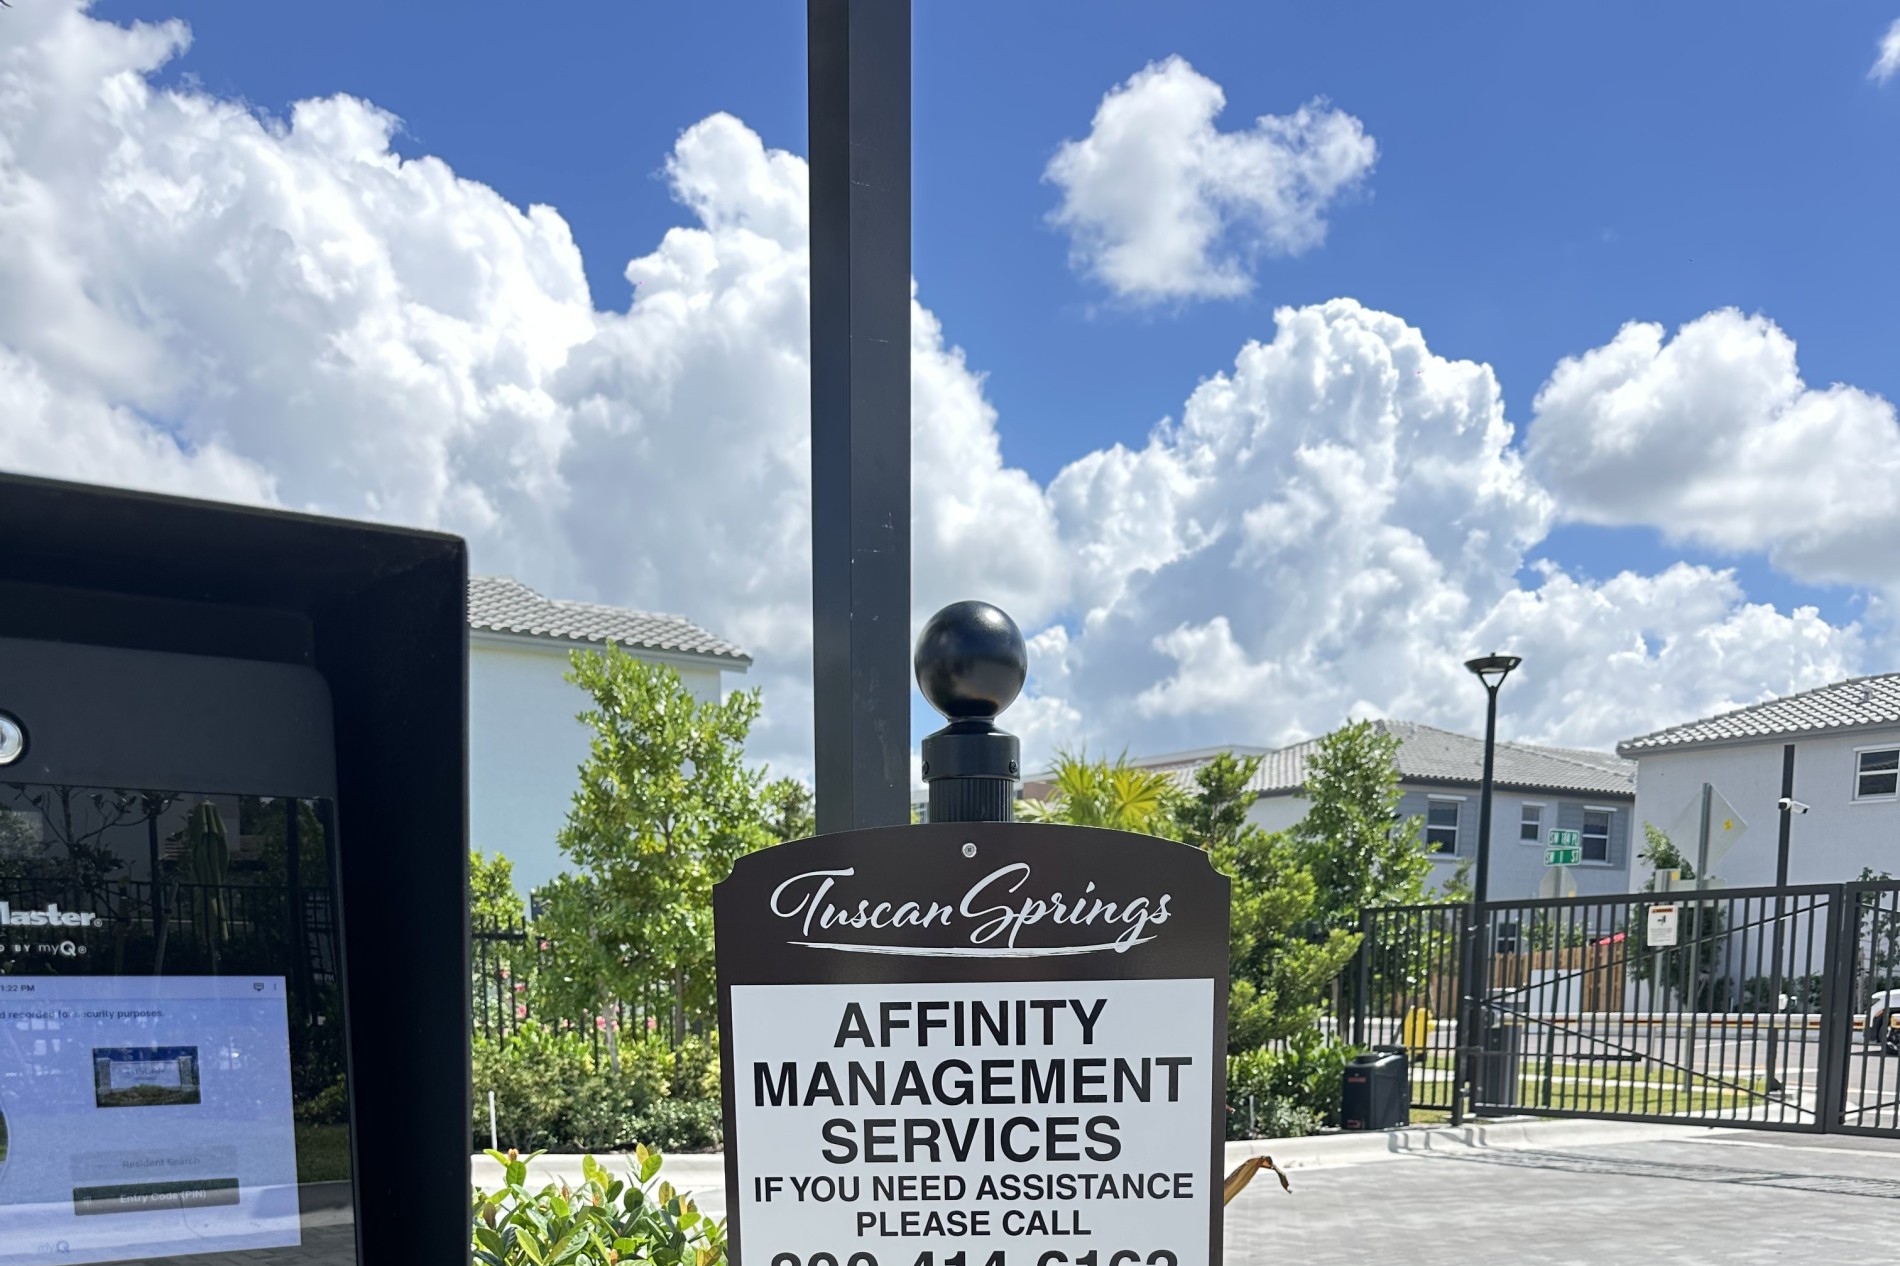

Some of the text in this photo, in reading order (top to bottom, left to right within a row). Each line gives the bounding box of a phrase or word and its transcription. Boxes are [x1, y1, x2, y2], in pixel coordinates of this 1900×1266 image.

[770, 862, 1172, 953] Tuscan Springs
[14, 944, 31, 952] BY
[20, 984, 35, 992] PM
[8, 1010, 56, 1019] recorded
[58, 1010, 73, 1018] fo
[75, 1009, 115, 1019] curity
[834, 999, 1107, 1047] AFFINITY
[754, 1057, 1192, 1106] MANAGEMENT
[822, 1116, 1121, 1164] SERVICES
[122, 1157, 200, 1169] Resident Search
[120, 1189, 207, 1204] Entry Code (PIN)
[755, 1173, 1193, 1202] IF YOU NEED ASSISTANCE
[857, 1210, 1091, 1236] PLEASE CALL
